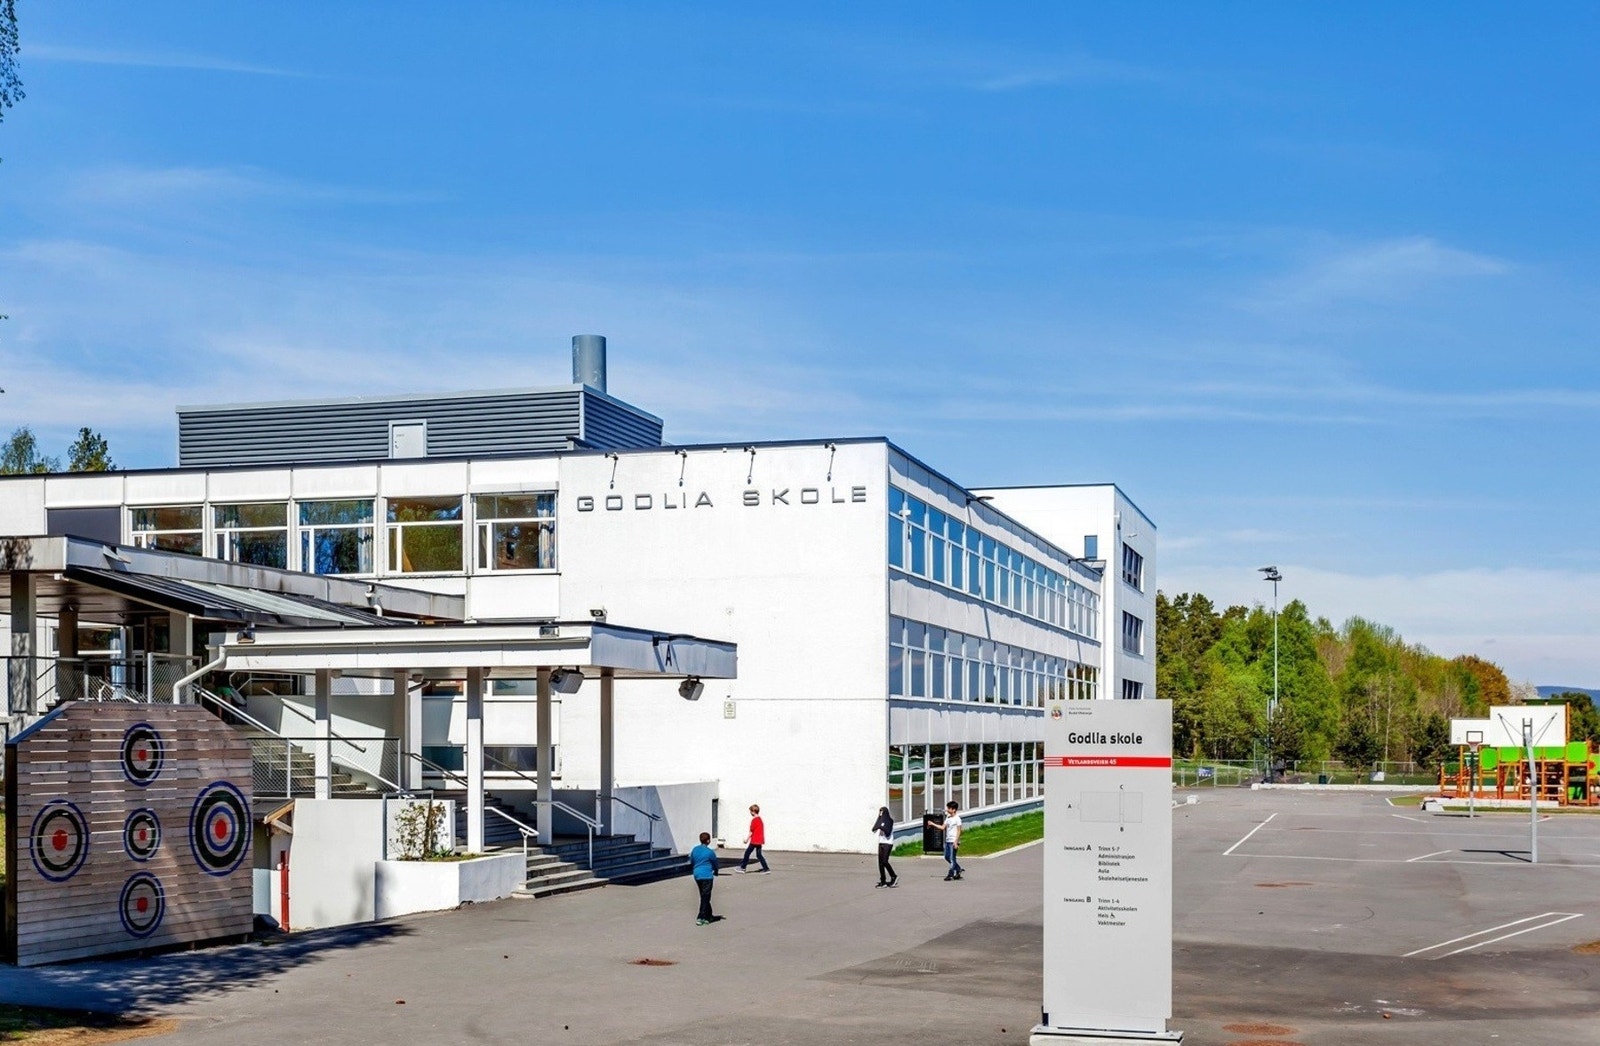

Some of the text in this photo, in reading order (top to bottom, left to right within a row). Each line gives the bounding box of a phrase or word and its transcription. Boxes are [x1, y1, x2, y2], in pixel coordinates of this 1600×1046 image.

[577, 486, 867, 513] GODLIA SKOLE
[665, 644, 673, 667] A
[1068, 732, 1143, 745] Godlia skole
